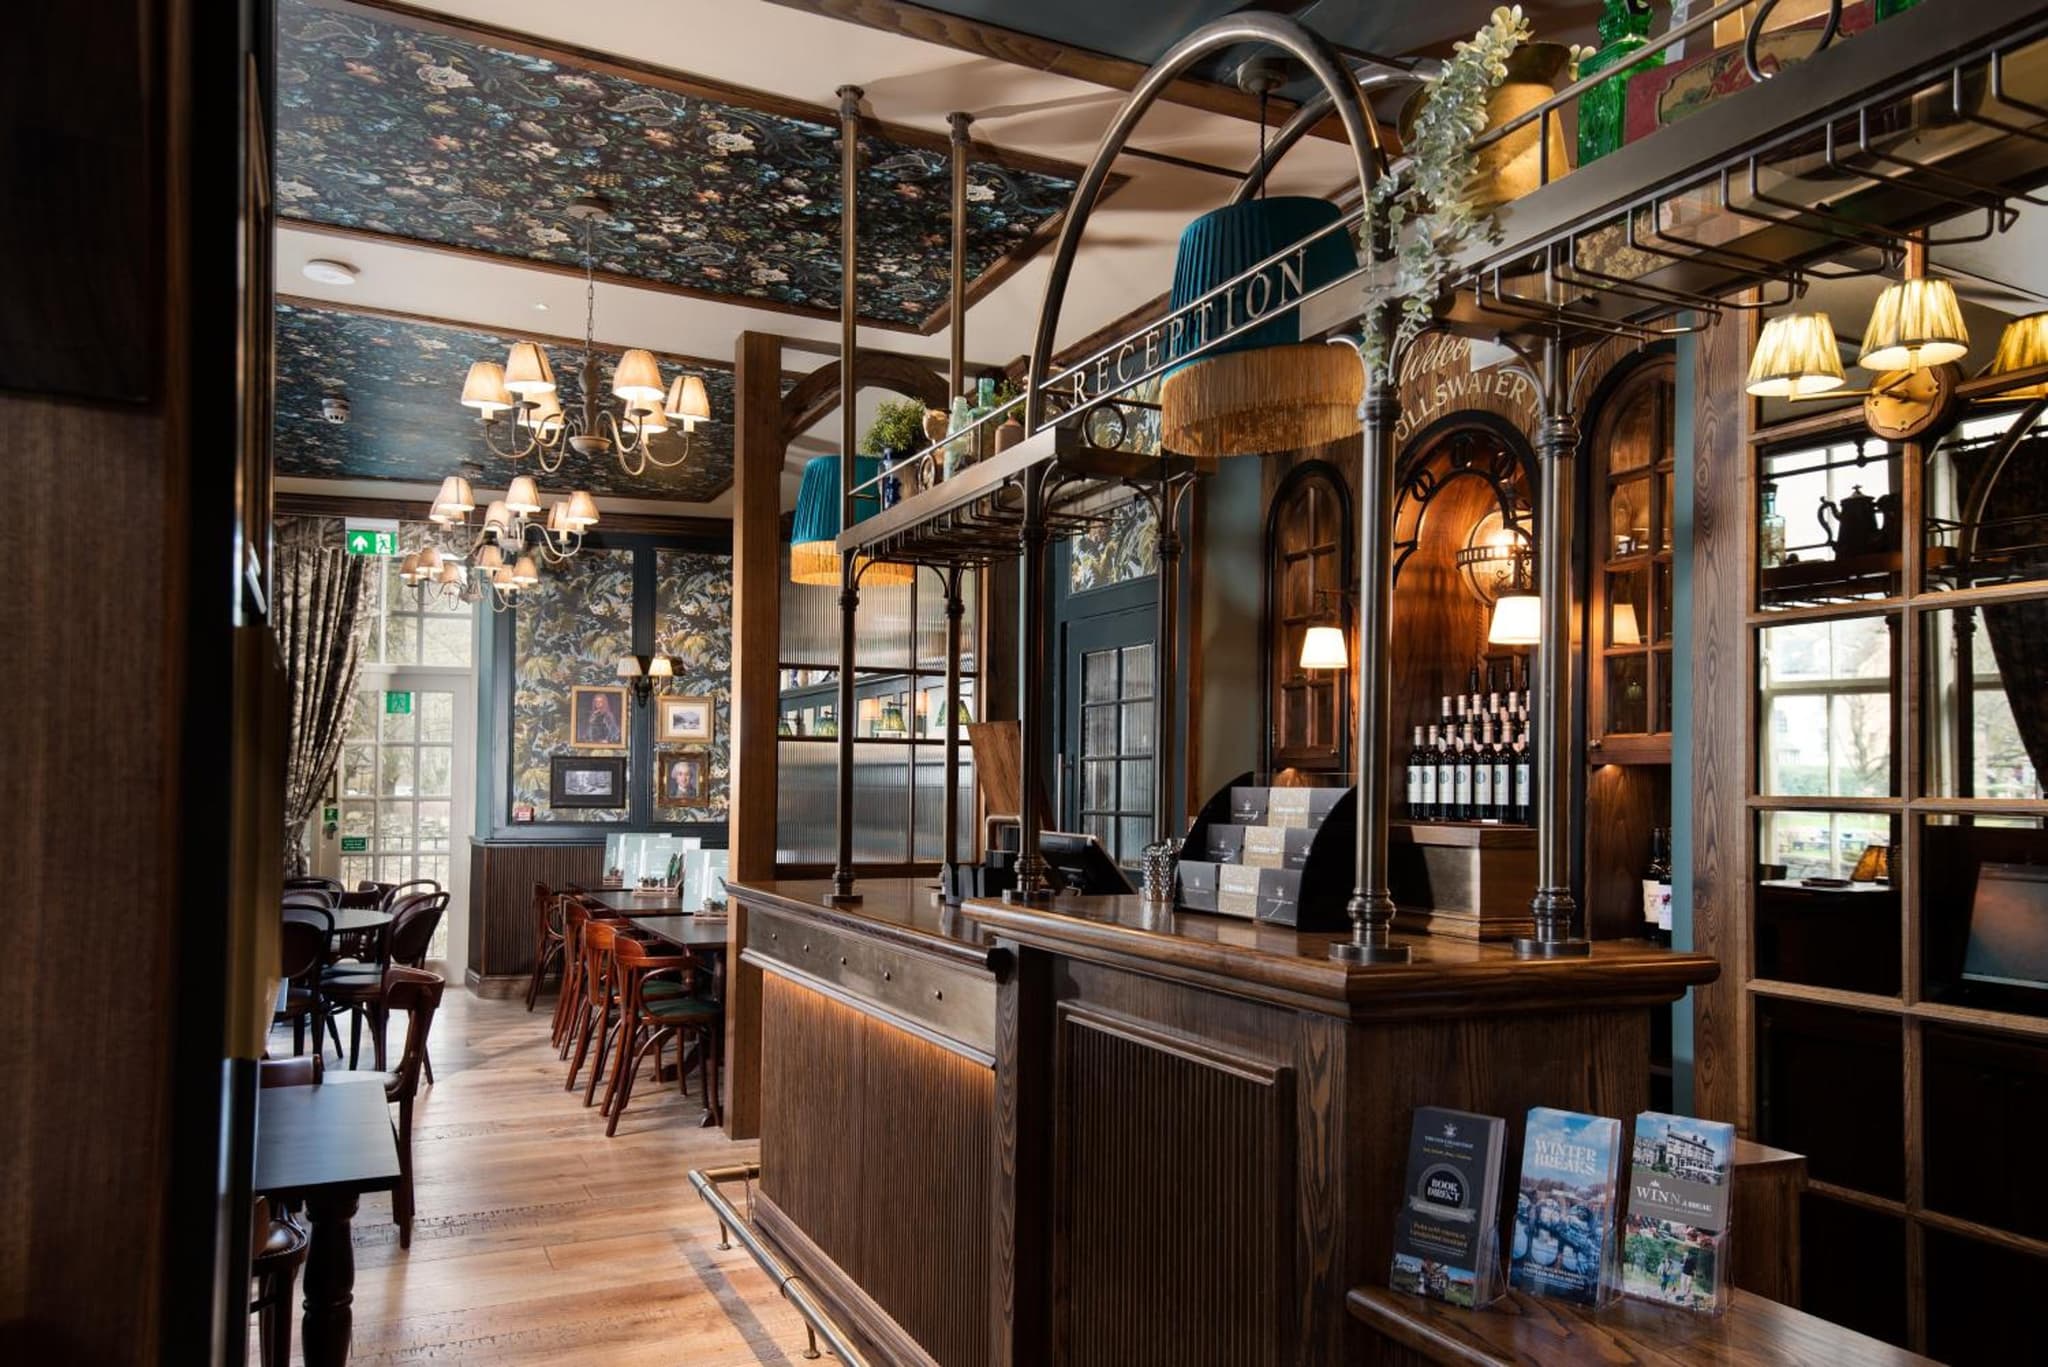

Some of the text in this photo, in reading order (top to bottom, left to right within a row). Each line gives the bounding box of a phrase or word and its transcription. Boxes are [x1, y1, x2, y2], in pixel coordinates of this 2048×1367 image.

[1068, 248, 1307, 409] RECEPTION
[1399, 334, 1470, 387] Welco
[1535, 1139, 1597, 1162] WINTER
[1534, 1152, 1597, 1176] BREAKS
[1427, 1187, 1461, 1201] DIRECT
[1431, 1178, 1459, 1193] BOOK
